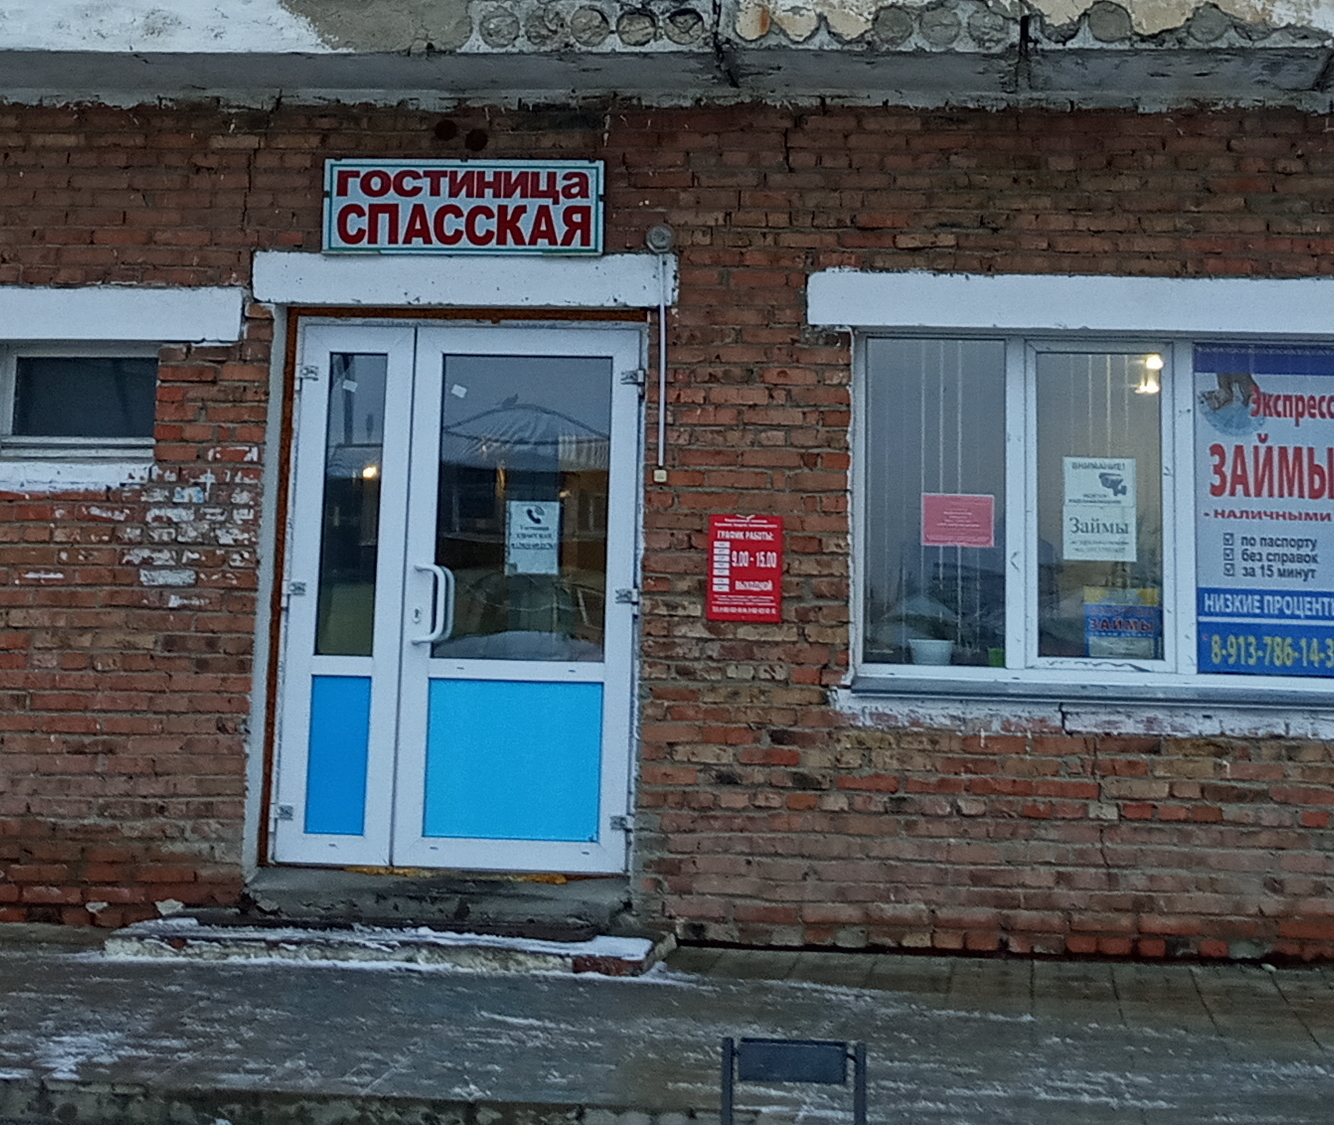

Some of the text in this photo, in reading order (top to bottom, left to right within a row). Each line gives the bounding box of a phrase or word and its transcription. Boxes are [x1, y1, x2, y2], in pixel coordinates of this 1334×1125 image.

[336, 203, 592, 247] СПАССКАЯ
[1069, 516, 1129, 534] Займы
[1240, 536, 1318, 552] по паспорту
[1240, 548, 1319, 565] без справок
[1241, 565, 1317, 582] за 15 минут
[1203, 592, 1261, 613] НИЗКИЕ
